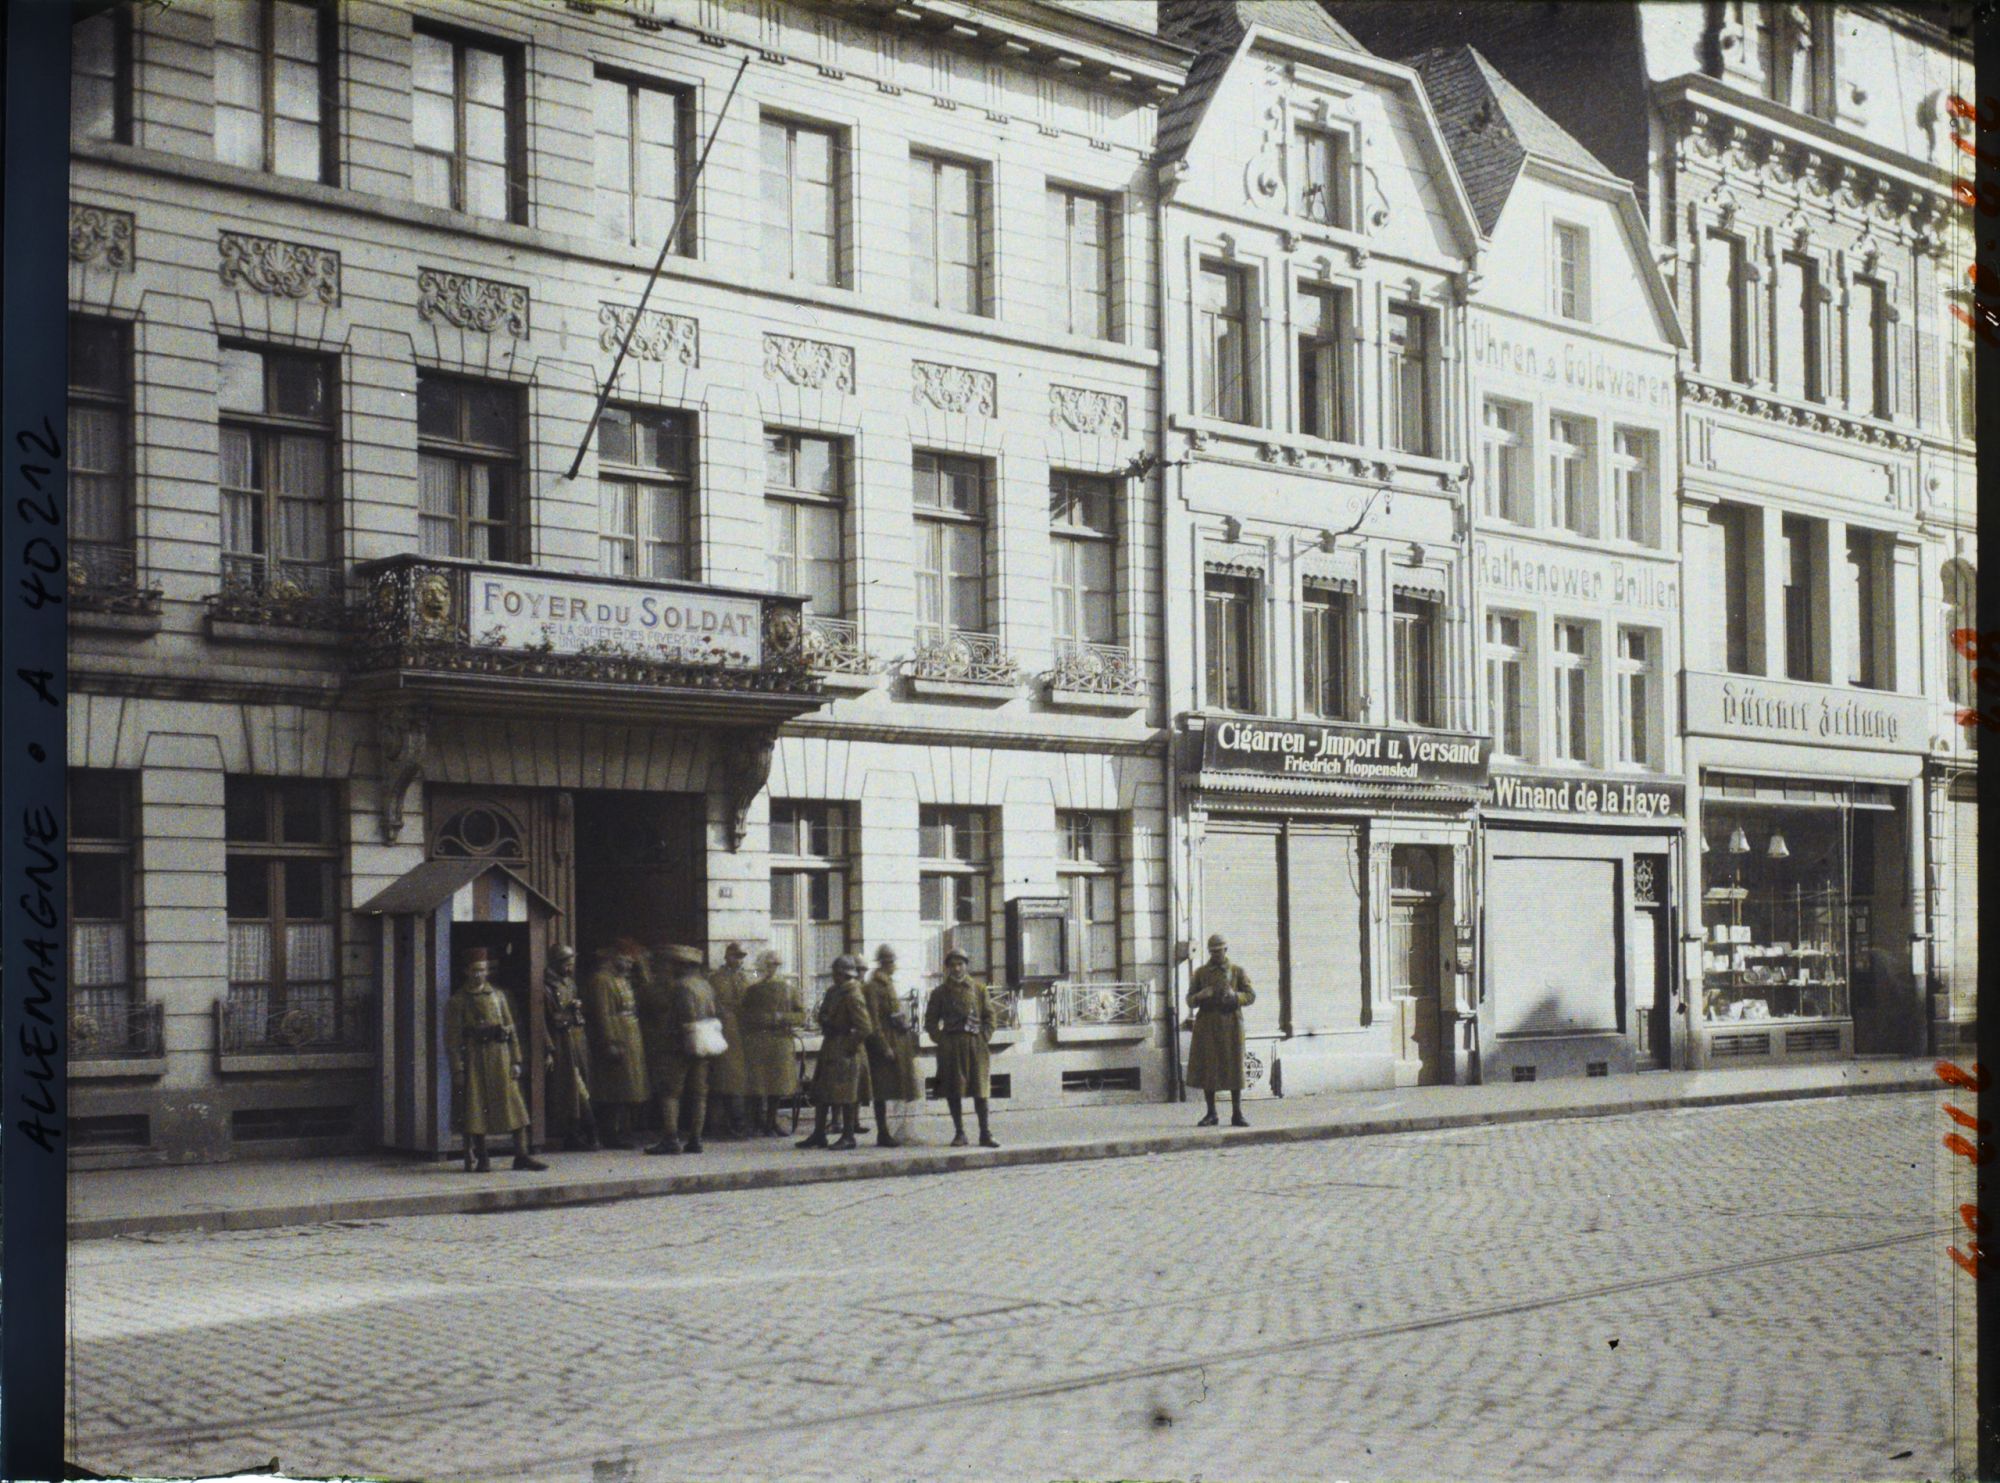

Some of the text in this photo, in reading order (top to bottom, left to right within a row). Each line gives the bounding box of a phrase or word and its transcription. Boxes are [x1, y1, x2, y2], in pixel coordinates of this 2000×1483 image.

[1472, 318, 1537, 376] Uhren
[1564, 342, 1671, 405] Goldwaren
[1474, 540, 1679, 610] Rathenower Brillen
[483, 582, 753, 636] FOYER DU SOLDAT
[1722, 683, 1898, 743] Dürener Zeitung
[1284, 755, 1341, 774] Friedrich
[1388, 740, 1403, 759] u.
[1408, 734, 1481, 765] Versand
[18, 416, 60, 1154] ALLEMAGNE A 40212
[1494, 776, 1672, 819] Winand de la Haye
